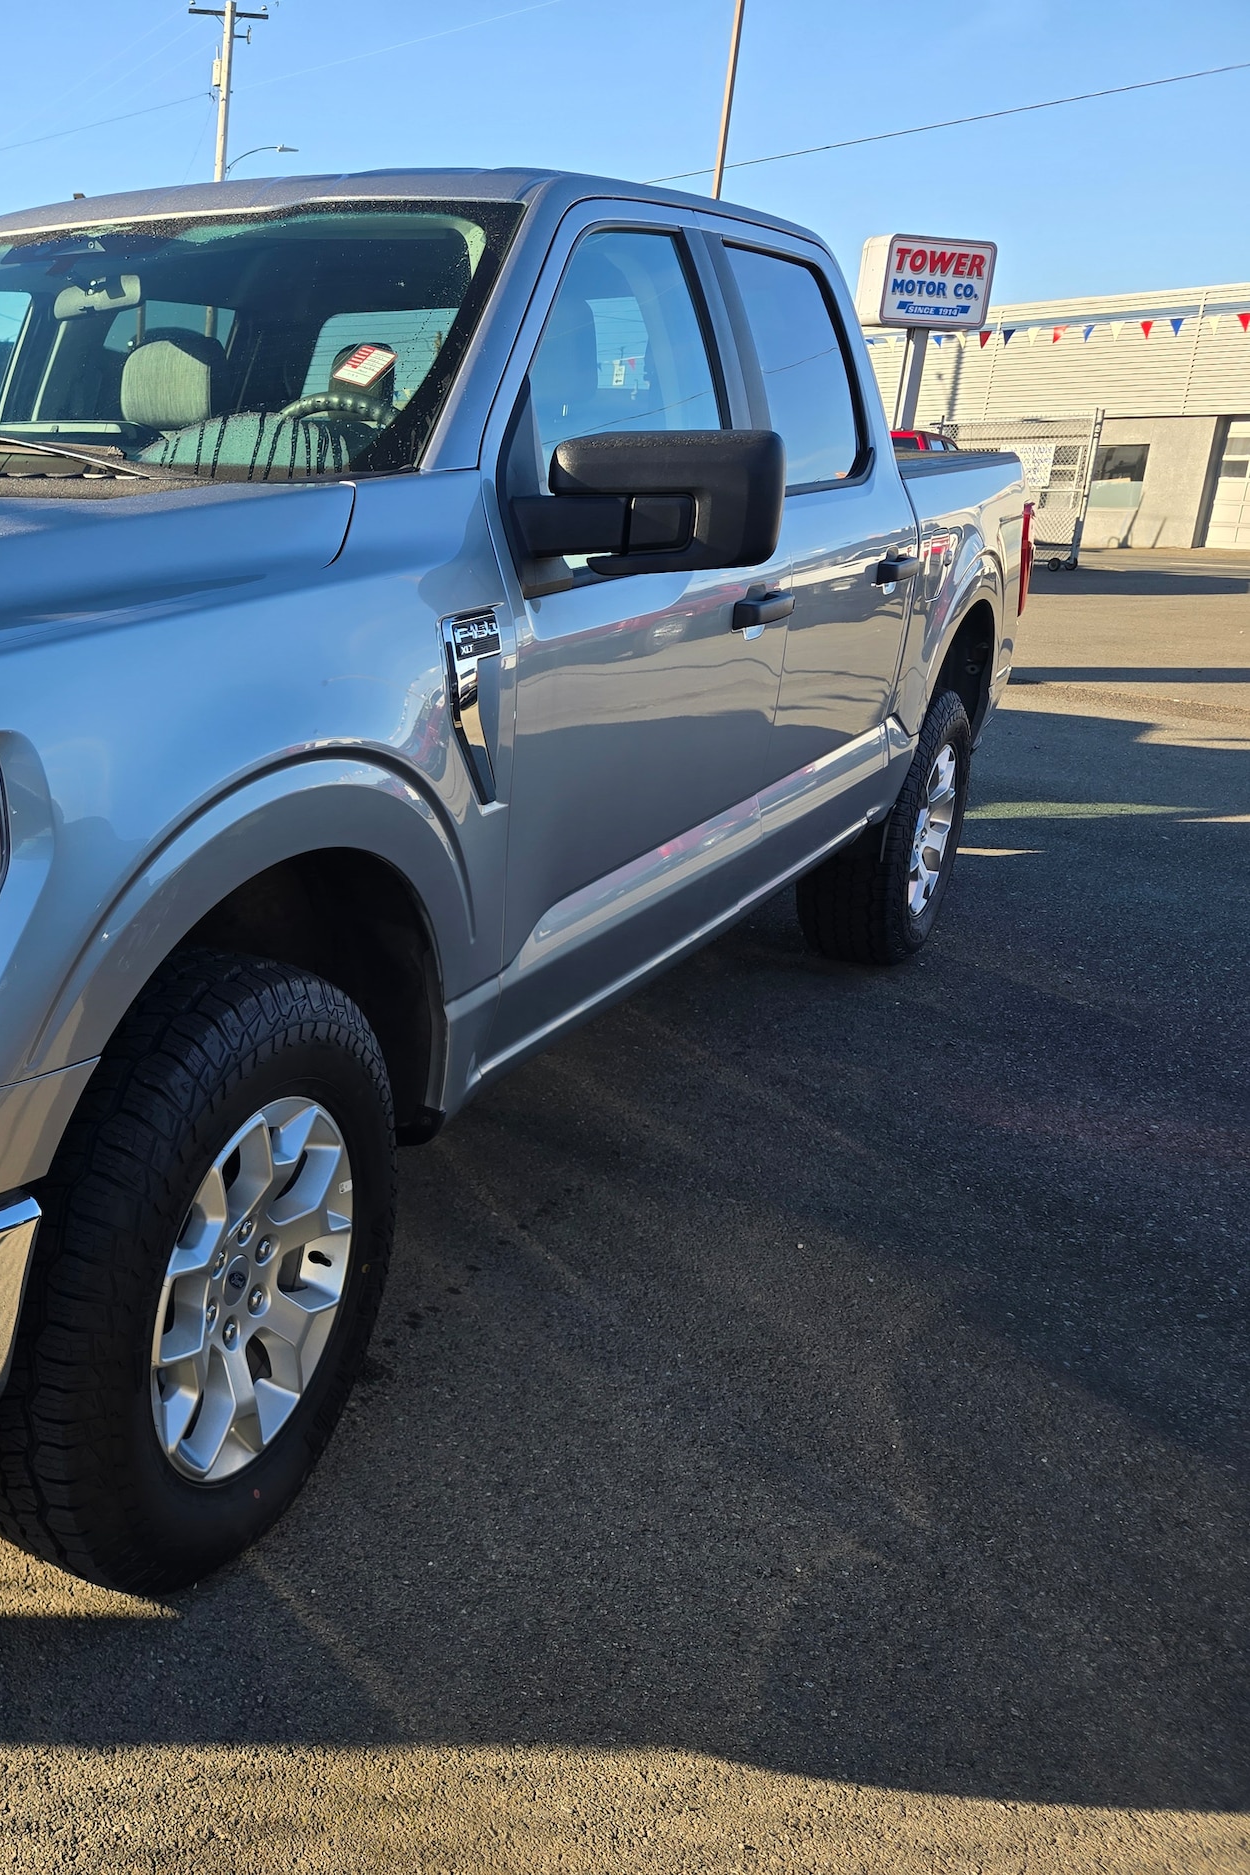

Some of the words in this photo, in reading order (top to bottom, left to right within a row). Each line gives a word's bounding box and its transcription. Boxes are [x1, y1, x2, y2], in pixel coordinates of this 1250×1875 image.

[896, 247, 986, 278] TOWER
[891, 278, 947, 298] MOTOR
[953, 283, 979, 299] CO.
[907, 305, 935, 315] SINCE
[938, 307, 958, 316] 1914
[460, 644, 474, 656] XLT
